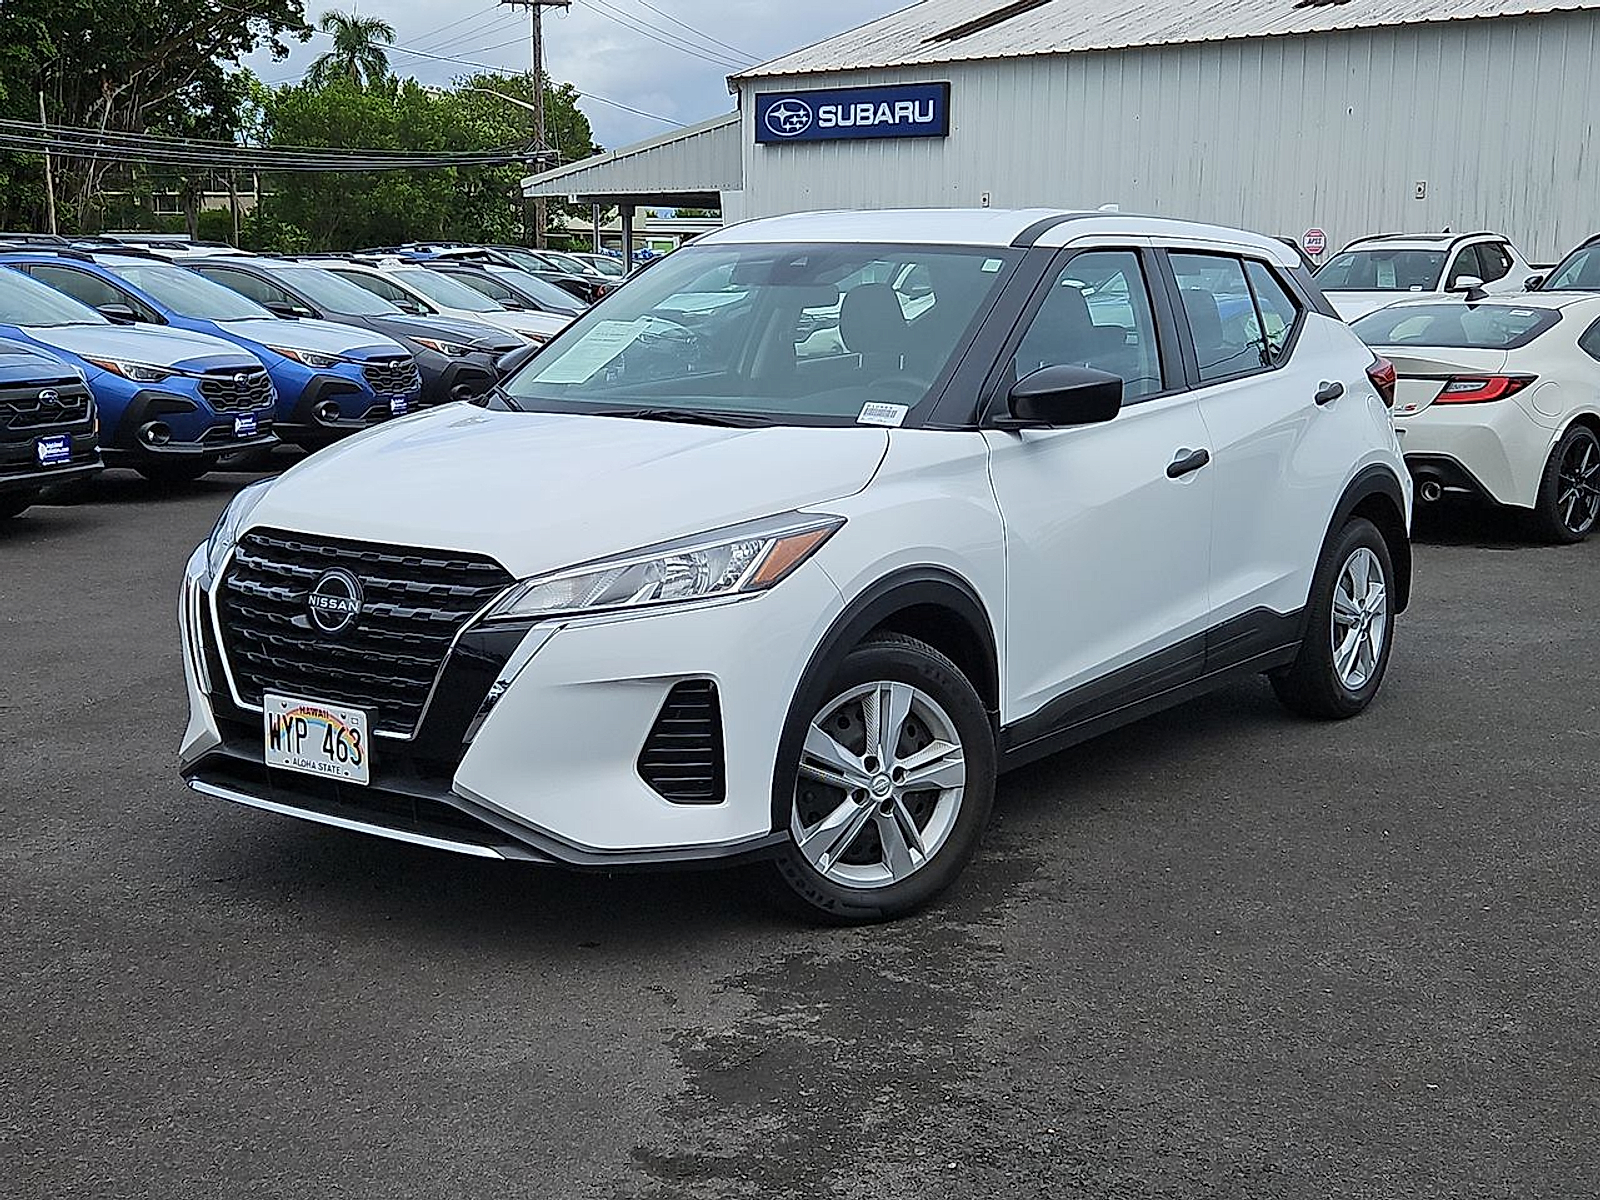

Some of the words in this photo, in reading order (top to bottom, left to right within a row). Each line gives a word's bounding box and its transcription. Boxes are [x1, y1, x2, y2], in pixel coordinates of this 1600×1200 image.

[818, 100, 934, 128] SUBARU
[308, 595, 359, 612] NISSAN
[298, 705, 329, 720] HAWAII
[268, 712, 308, 755] WYP
[322, 723, 362, 766] 463
[293, 757, 317, 770] ALOHA
[317, 763, 342, 775] STATE
